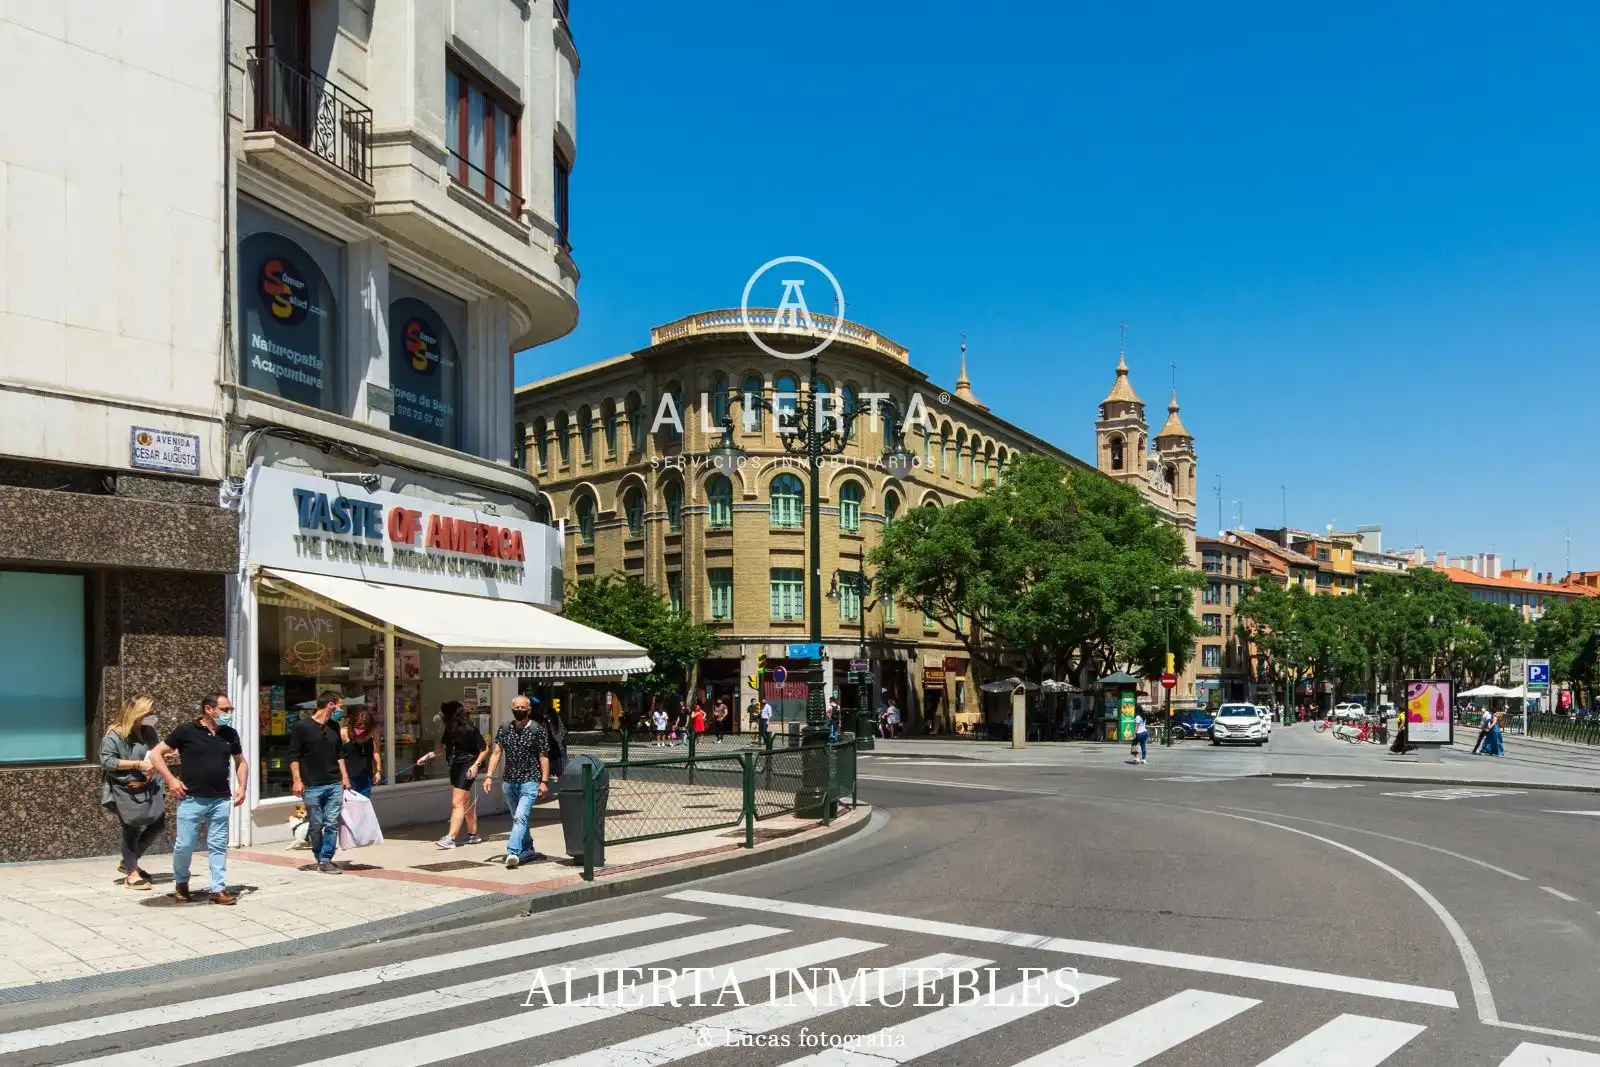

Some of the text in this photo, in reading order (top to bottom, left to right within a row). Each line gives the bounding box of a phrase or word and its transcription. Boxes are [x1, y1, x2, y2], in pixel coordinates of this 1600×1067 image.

[252, 354, 324, 389] Acupuntura
[418, 394, 431, 408] de
[156, 435, 191, 447] AVENIDA
[163, 451, 197, 465] AUGUSTO
[292, 488, 526, 562] TASTE OF AMERICA
[514, 655, 597, 670] TASTE OF AMERICA
